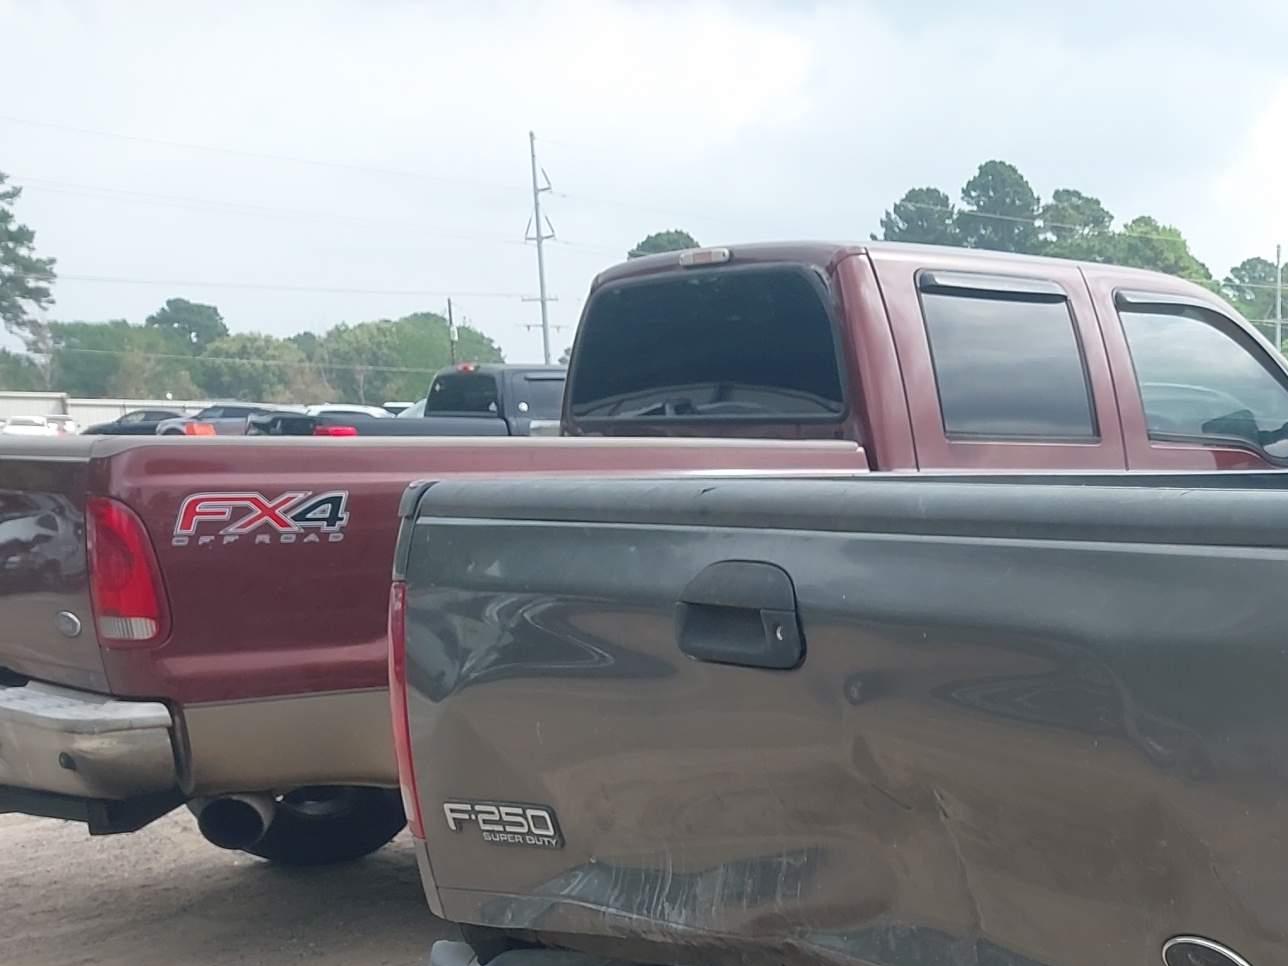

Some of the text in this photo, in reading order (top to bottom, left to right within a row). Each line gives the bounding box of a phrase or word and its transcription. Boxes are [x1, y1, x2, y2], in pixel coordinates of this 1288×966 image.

[172, 489, 350, 536] FX4
[171, 532, 345, 546] OFF ROAD
[482, 831, 558, 848] SUPER DUTY
